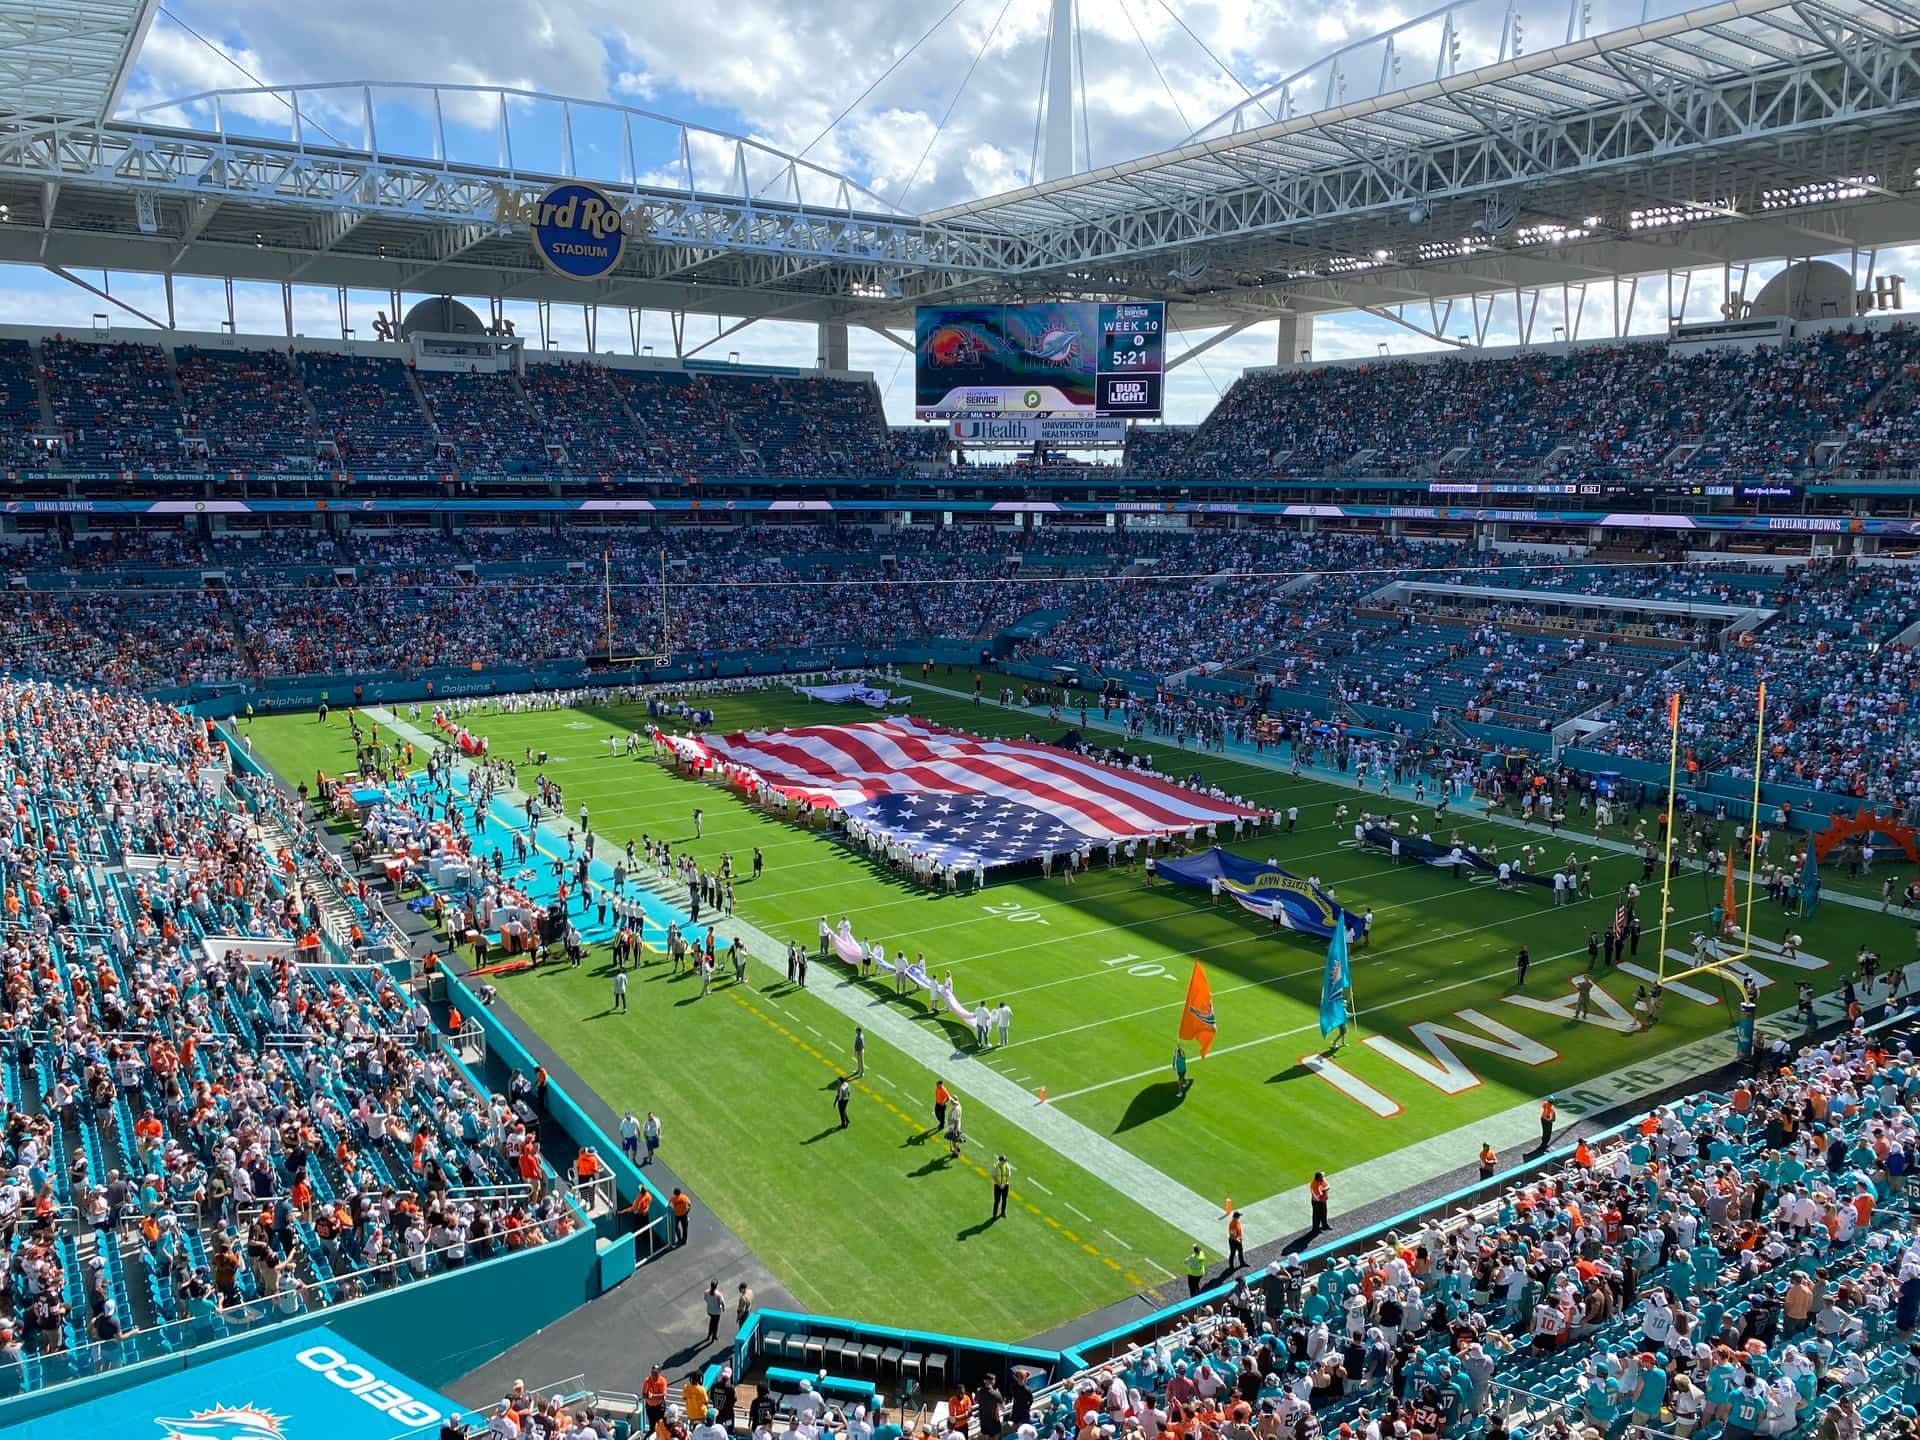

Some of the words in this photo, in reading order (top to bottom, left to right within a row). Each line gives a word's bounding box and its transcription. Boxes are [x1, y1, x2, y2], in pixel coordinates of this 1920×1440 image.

[496, 189, 577, 228] Hard
[552, 243, 608, 257] STADIUM
[1104, 322, 1138, 331] WEEK
[1144, 321, 1158, 330] 10
[1113, 351, 1147, 365] 5:21
[1116, 384, 1140, 392] BUD
[1111, 392, 1145, 401] LIGHT
[1042, 421, 1084, 429] UNIVERSITY
[1085, 421, 1094, 429] OF
[1096, 421, 1120, 429] MIAMI
[1042, 430, 1069, 438] HEALTH
[1070, 430, 1099, 438] SYSTEM
[35, 501, 56, 511] MIAMI
[58, 501, 94, 511] DOLPHINS
[1769, 517, 1806, 530] CLEVELAND
[1809, 518, 1841, 531] BROWNS
[441, 683, 490, 694] Dolphins
[258, 695, 313, 707] Dolphins
[1259, 875, 1280, 885] NAVY
[1282, 878, 1309, 891] STATES
[982, 902, 1042, 922] 20
[1103, 953, 1166, 976] 10
[1300, 929, 1832, 1119] MIAMI
[1610, 1070, 1665, 1094] OF
[1552, 1089, 1614, 1115] US
[1327, 1282, 1336, 1293] 10
[1541, 1319, 1555, 1330] 10
[1652, 1319, 1665, 1329] 10
[295, 1346, 442, 1426] GEICO
[1442, 1396, 1453, 1408] 17
[1416, 1411, 1437, 1425] 24
[1740, 1406, 1756, 1420] 10
